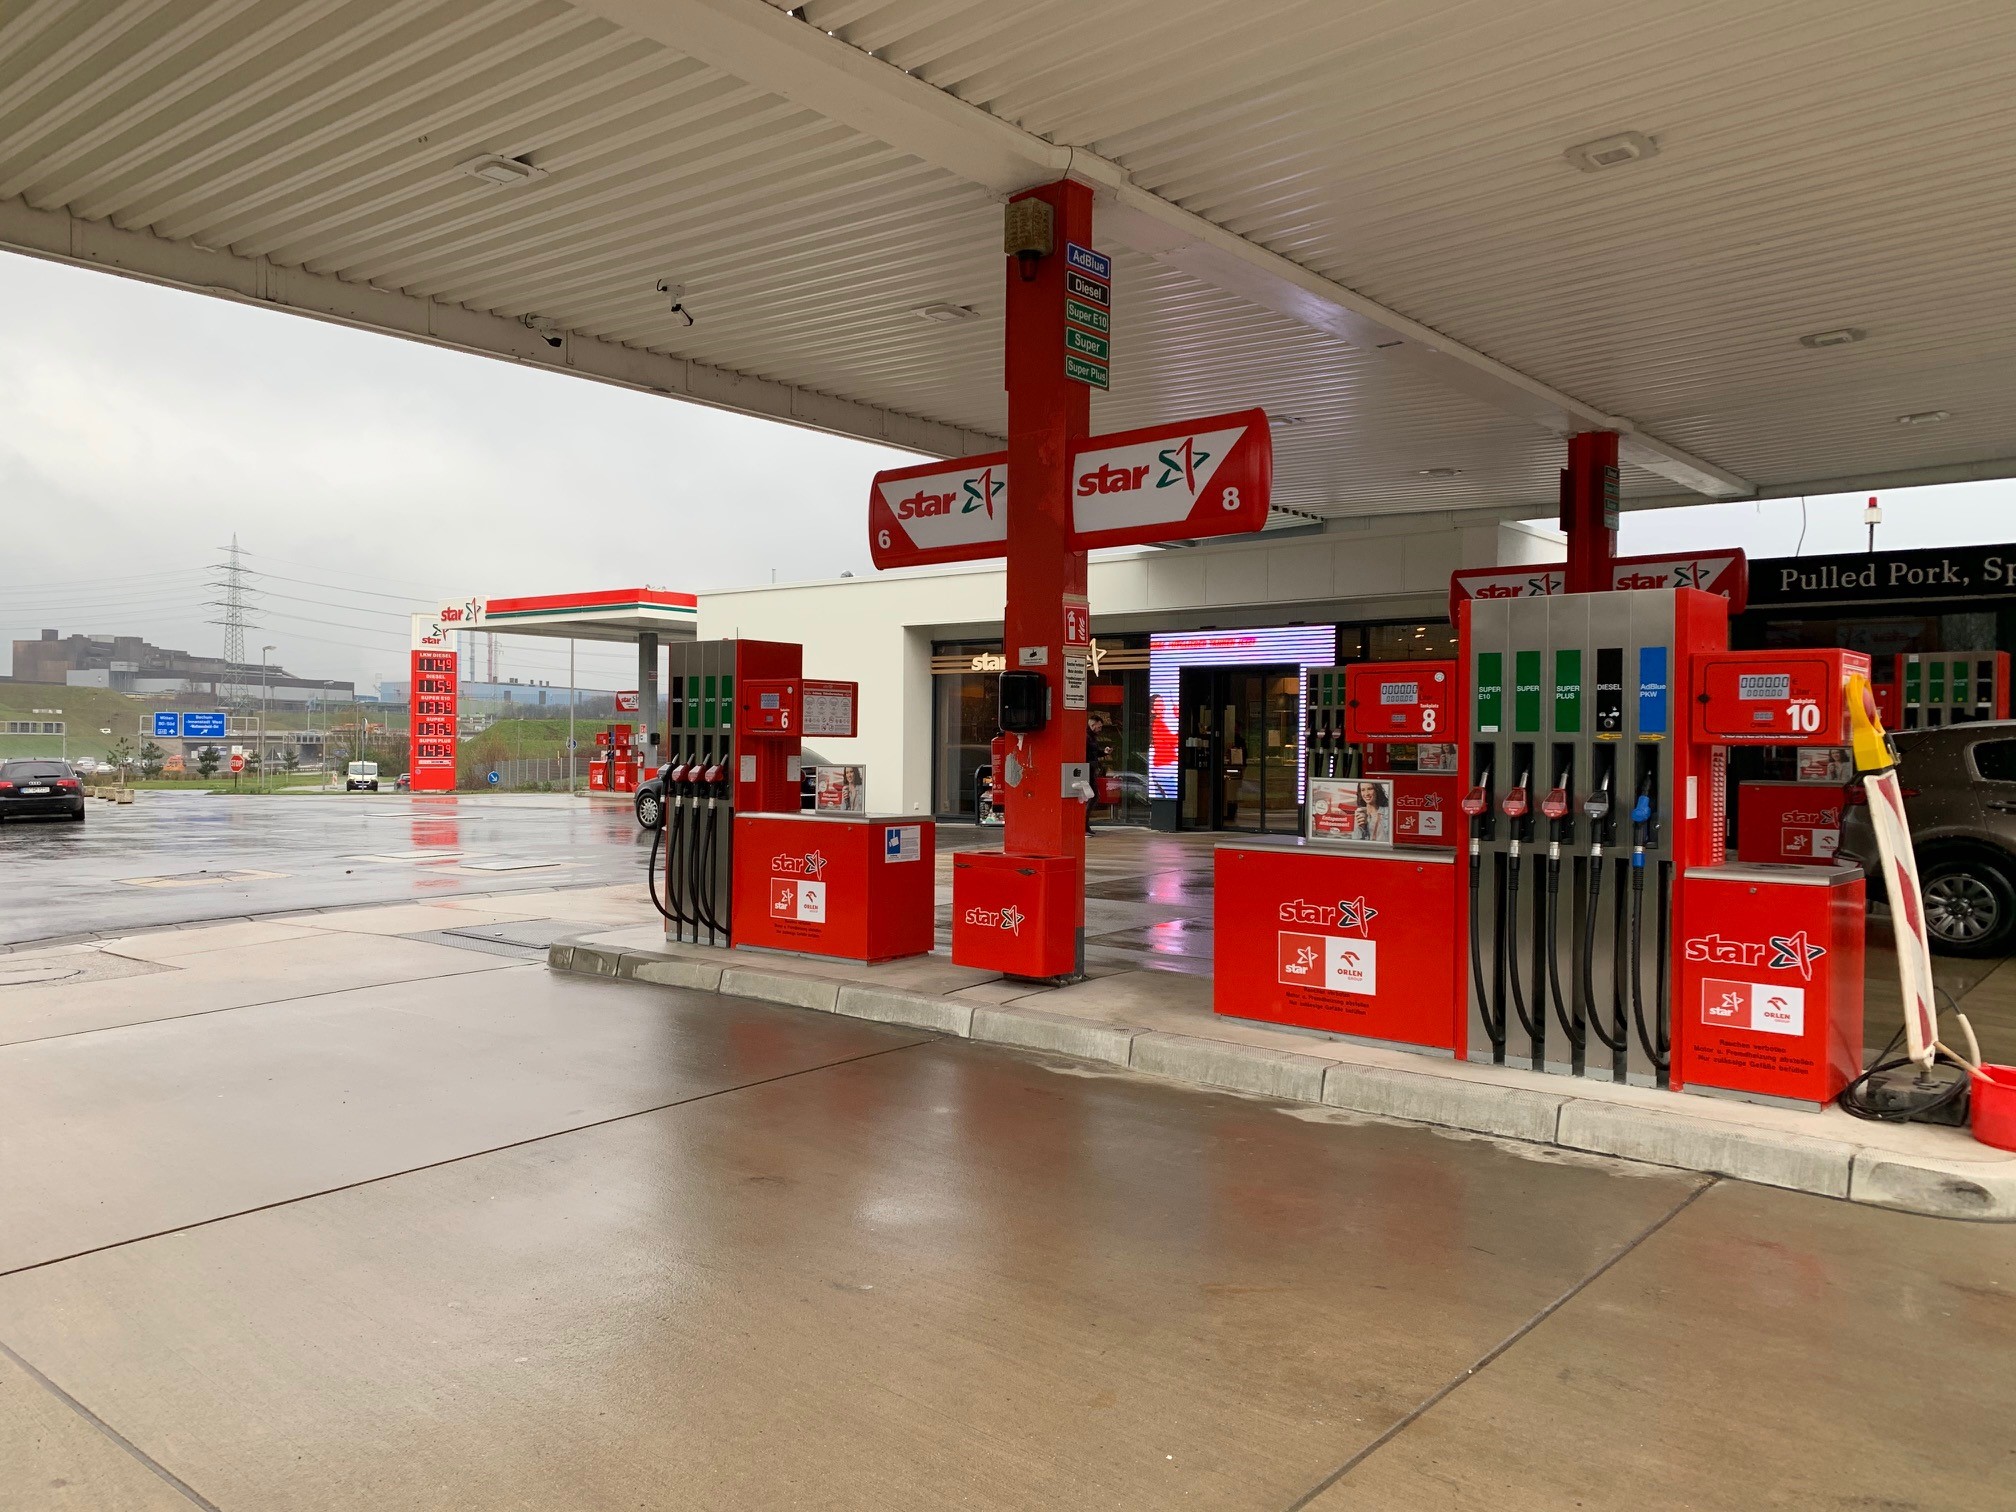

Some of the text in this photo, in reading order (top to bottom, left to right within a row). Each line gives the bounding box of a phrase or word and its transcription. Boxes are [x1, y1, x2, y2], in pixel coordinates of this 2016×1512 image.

[1073, 250, 1105, 273] AdBlue
[1075, 278, 1102, 299] Diesel
[1068, 304, 1107, 328] Super E10
[1074, 333, 1100, 353] Super
[1068, 361, 1106, 381] Super Plus
[1077, 463, 1150, 498] star
[897, 488, 957, 520] star
[1222, 487, 1241, 510] 8
[878, 529, 891, 549] 6
[1616, 572, 1668, 590] star
[1780, 563, 1877, 591] Pulled
[1888, 560, 1970, 586] Pork,
[1475, 583, 1523, 600] star
[441, 606, 464, 621] star
[422, 636, 441, 644] star
[971, 652, 1007, 671] star
[781, 711, 789, 728] 6
[1422, 709, 1436, 732] 8
[1786, 704, 1820, 732] 10
[1396, 795, 1423, 807] star
[1781, 810, 1819, 824] star
[771, 854, 804, 872] star
[774, 902, 788, 910] star
[1280, 899, 1335, 925] star
[966, 907, 1000, 926] star
[1685, 934, 1765, 966] star
[1285, 963, 1308, 975] star
[1337, 968, 1363, 977] ORLEN
[1709, 1006, 1734, 1017] star
[1764, 1012, 1790, 1020] ORLEN
[1693, 1044, 1714, 1053] Motor
[1726, 1049, 1776, 1062] Fremdheizung
[1780, 1056, 1814, 1067] abstellen
[1719, 1039, 1786, 1053] Rauchen verboten
[1779, 1064, 1809, 1074] befüllen
